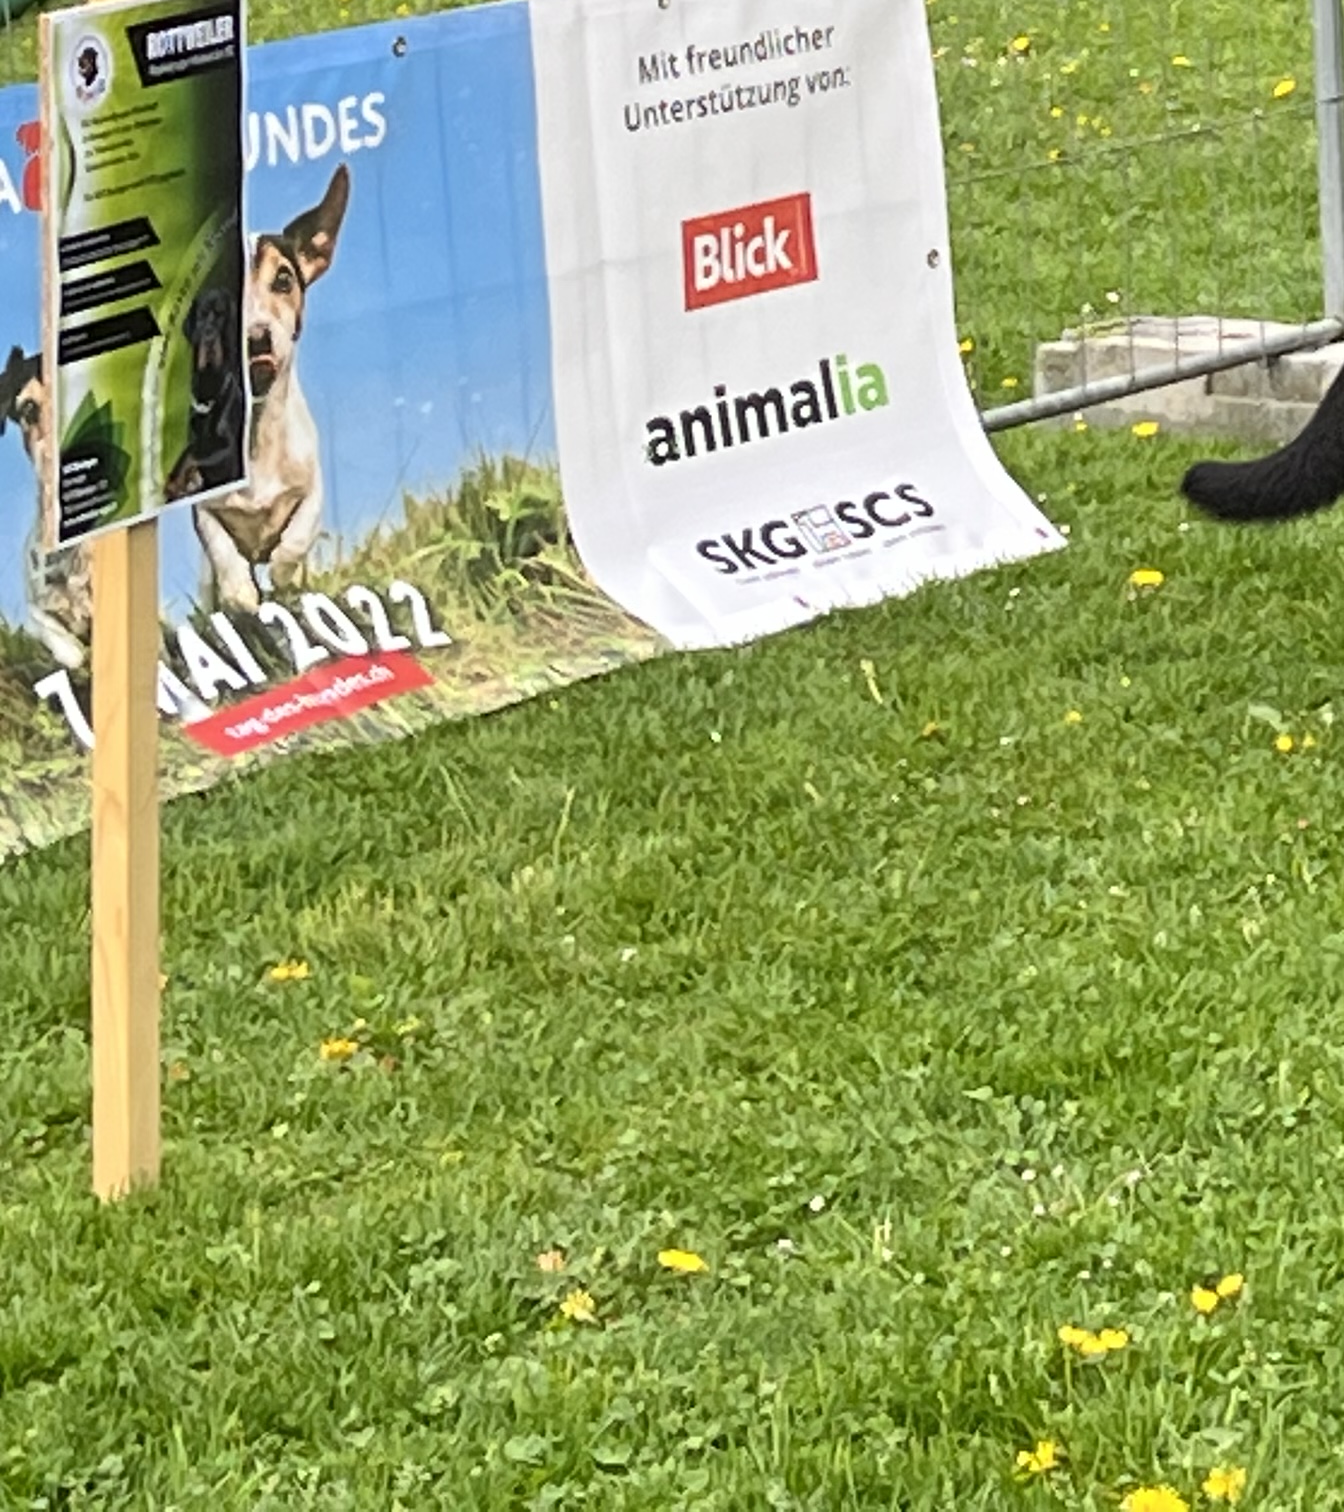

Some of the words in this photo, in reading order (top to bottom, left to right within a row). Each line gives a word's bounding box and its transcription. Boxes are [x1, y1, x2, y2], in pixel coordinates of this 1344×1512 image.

[638, 50, 681, 85] Mit
[685, 25, 835, 75] freundlicher
[623, 76, 801, 132] Unterstützung
[805, 65, 852, 94] von:
[693, 215, 793, 292] Blick
[645, 353, 889, 466] animalia
[696, 520, 807, 574] SKG
[834, 483, 934, 539] SCS
[259, 579, 452, 675] 2022
